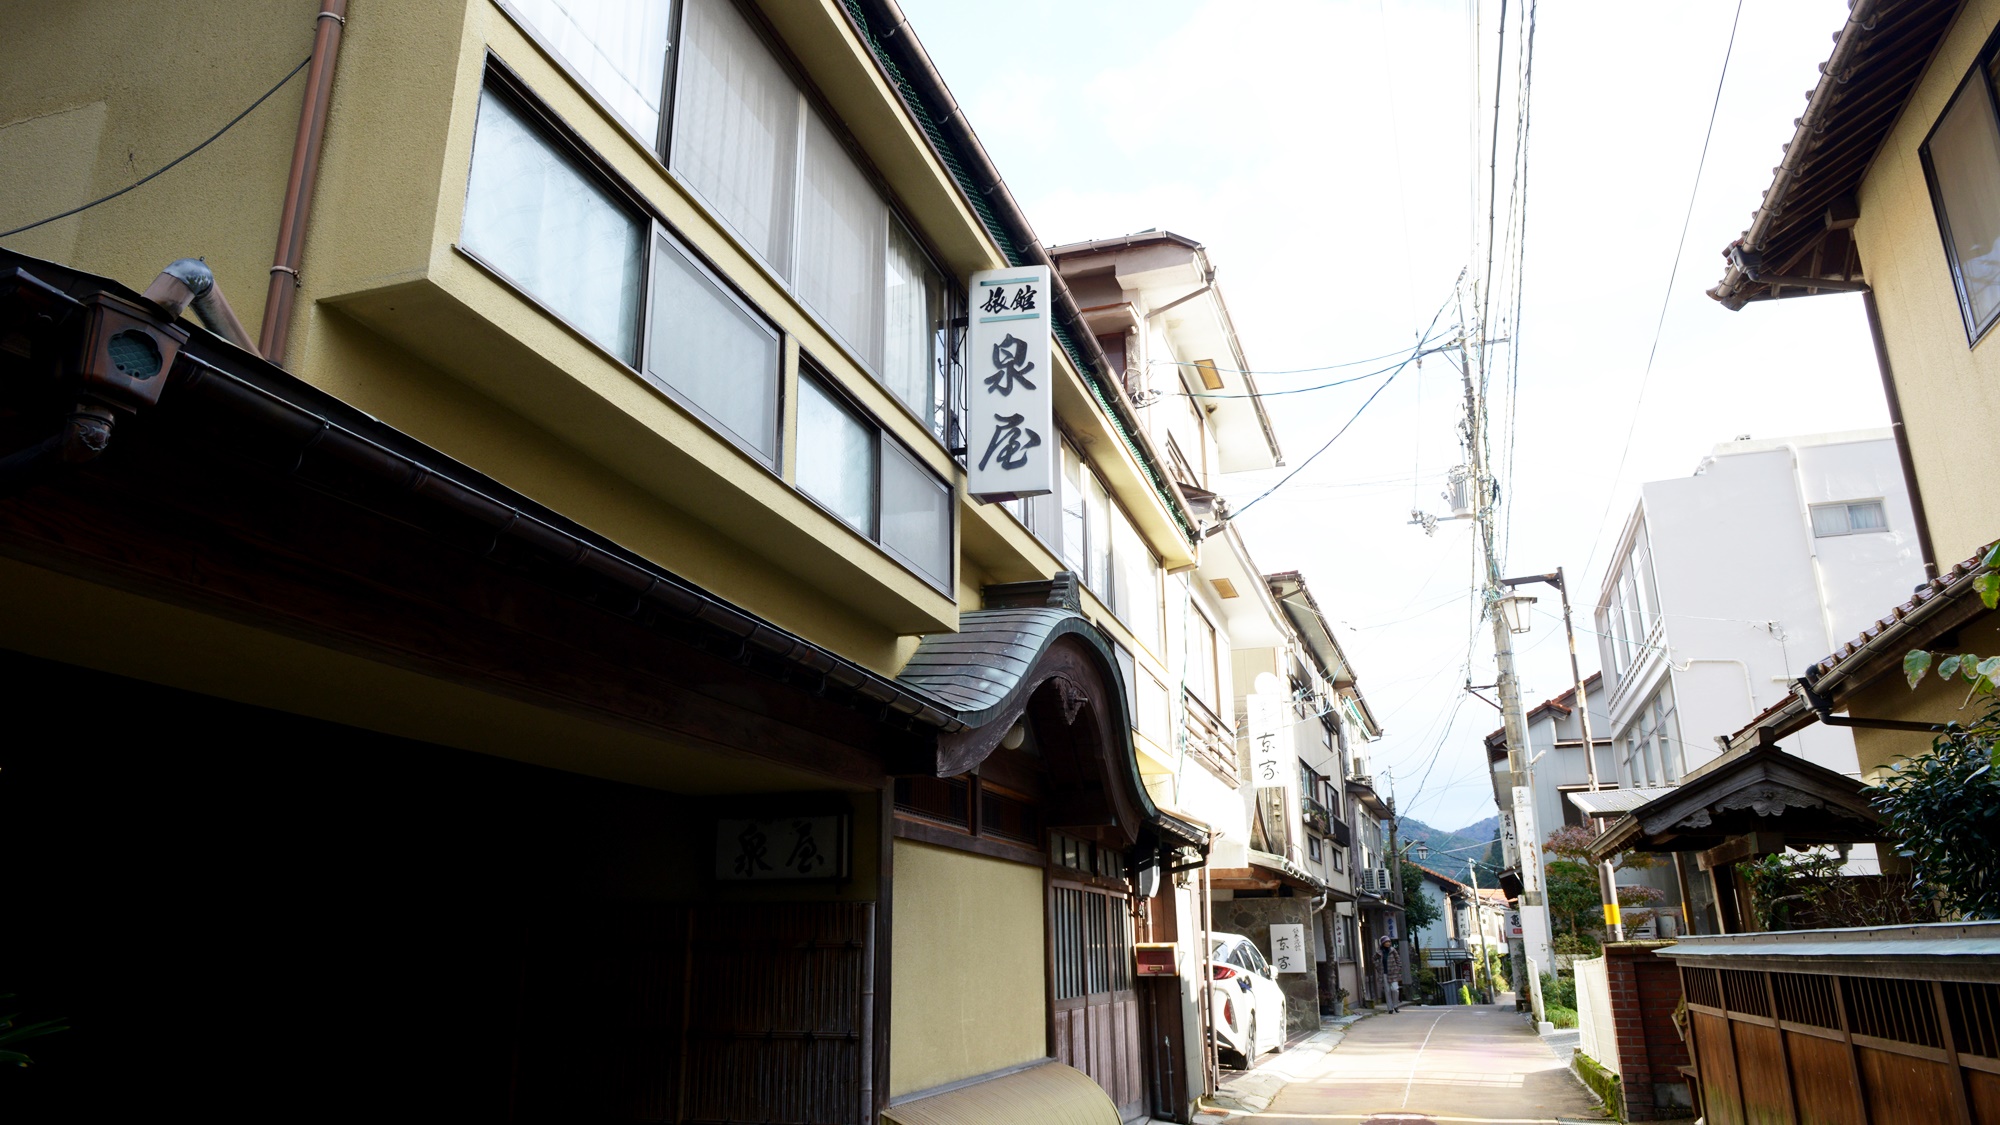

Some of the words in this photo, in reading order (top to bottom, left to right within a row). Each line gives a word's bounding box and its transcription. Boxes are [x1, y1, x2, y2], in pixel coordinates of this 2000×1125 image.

[980, 285, 1037, 313] 旅館
[979, 333, 1042, 472] 泉屋
[735, 820, 825, 878] 泉屋
